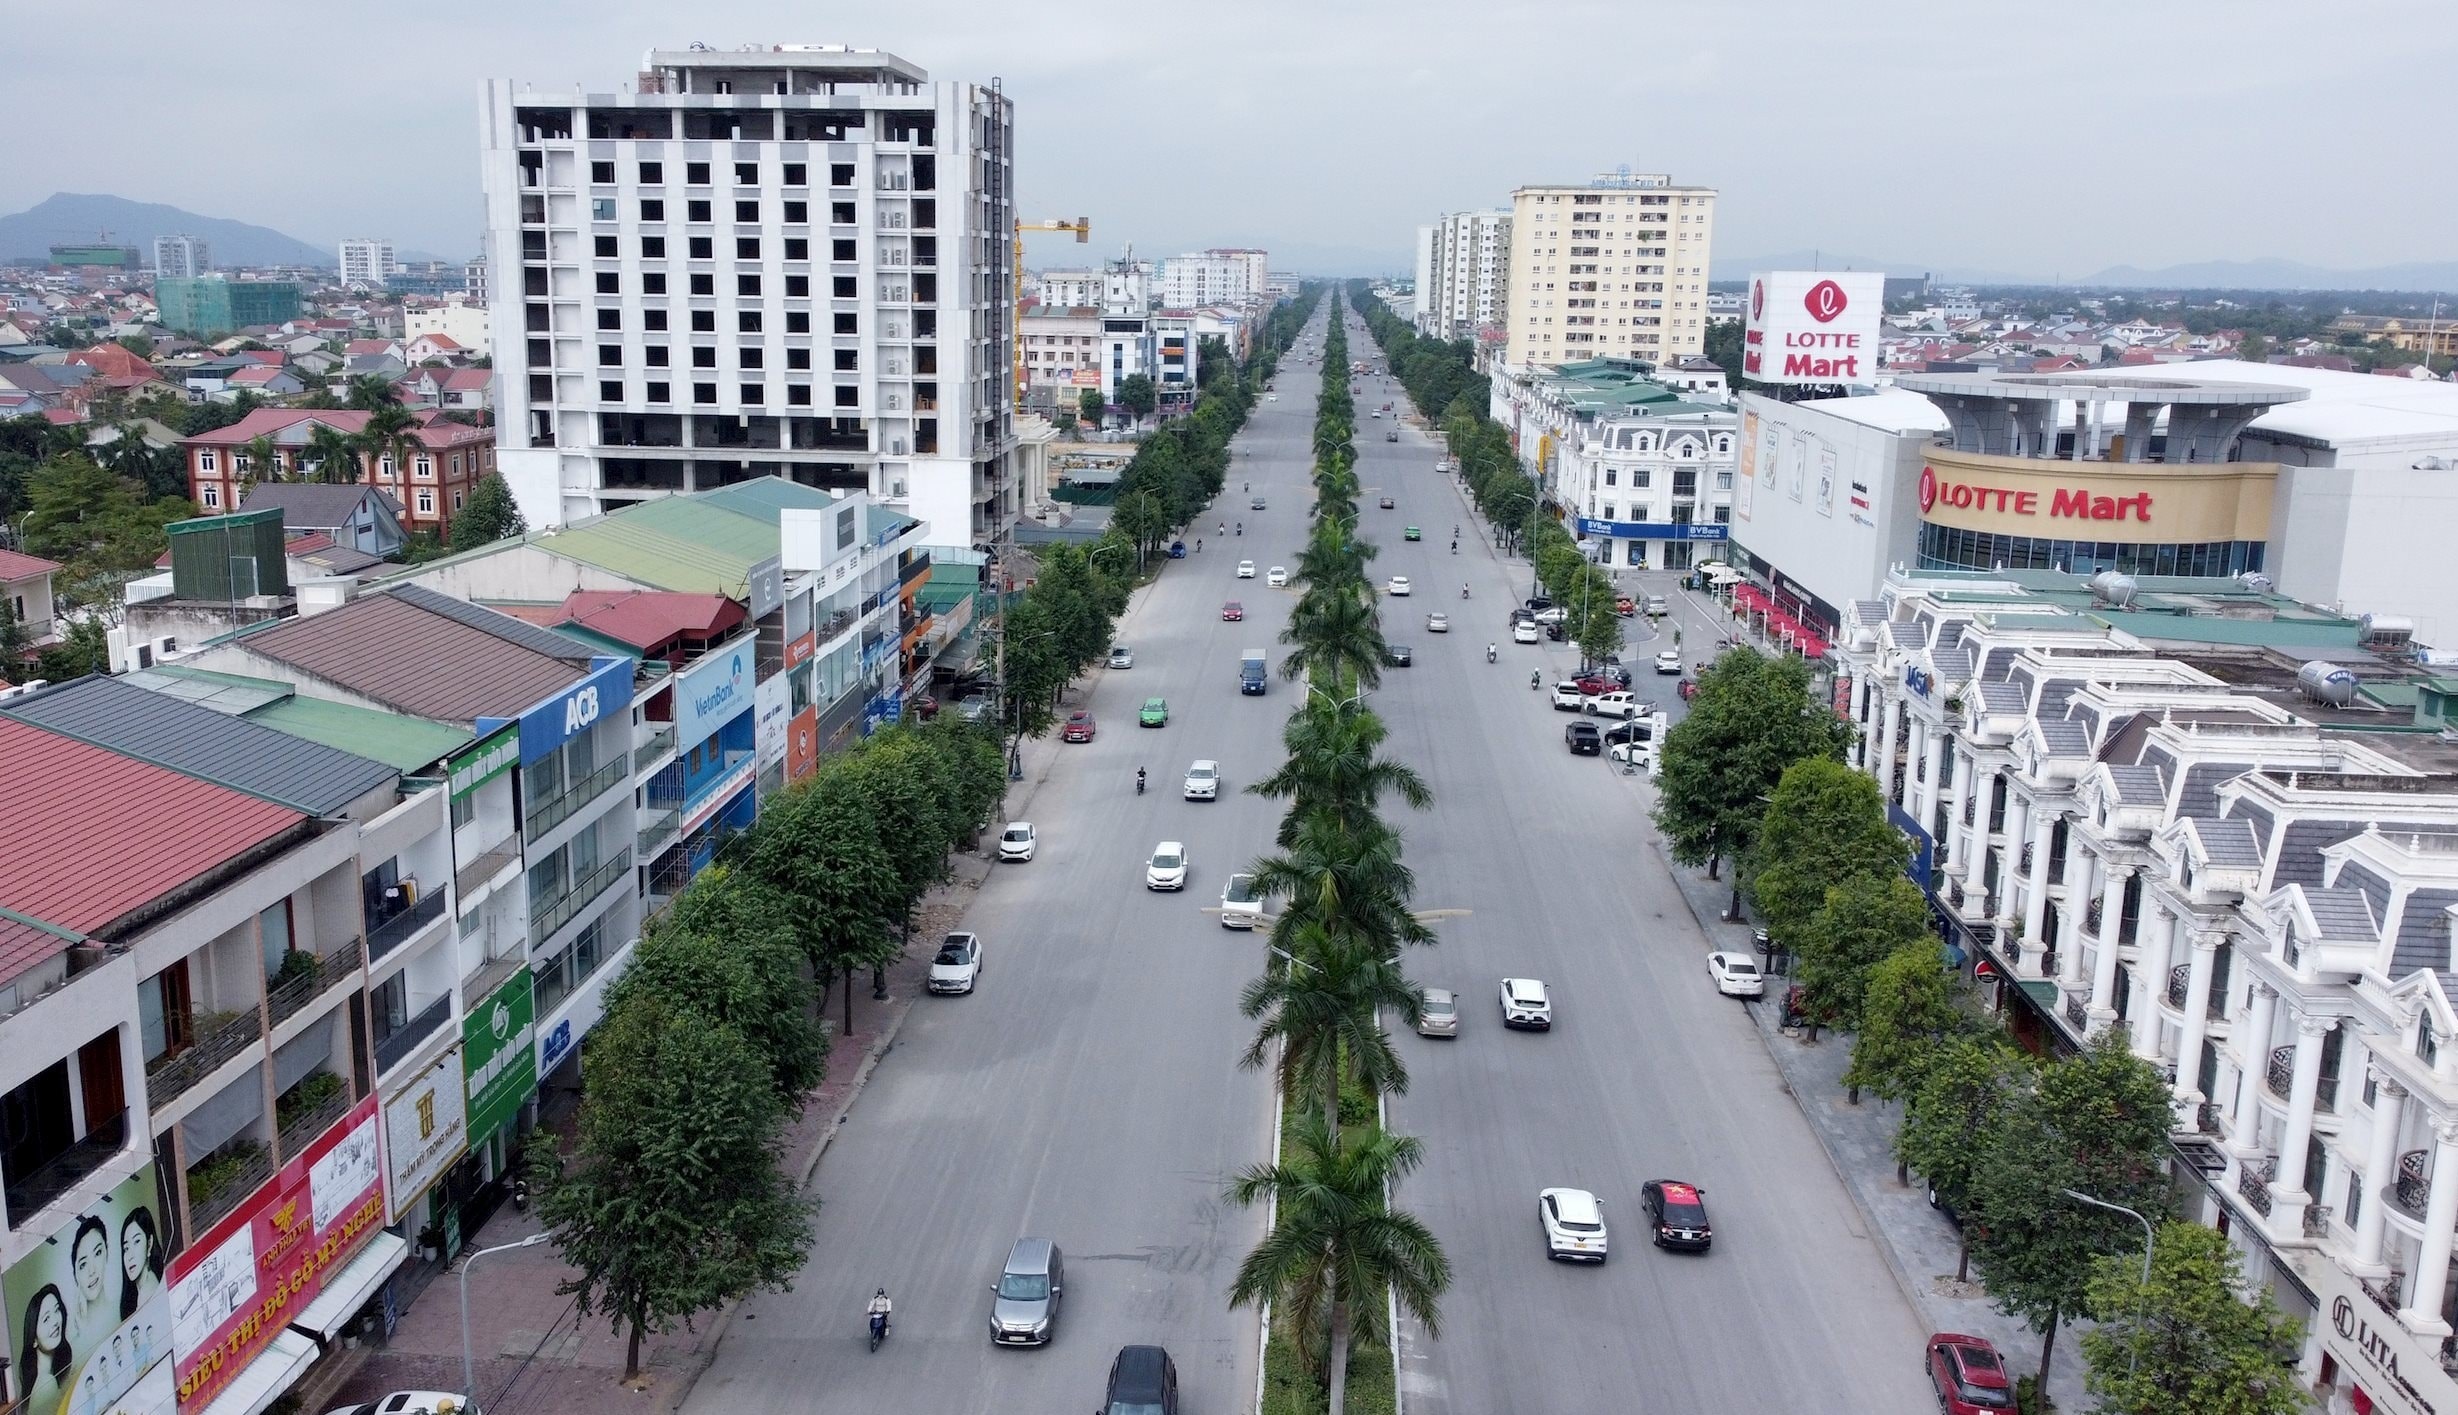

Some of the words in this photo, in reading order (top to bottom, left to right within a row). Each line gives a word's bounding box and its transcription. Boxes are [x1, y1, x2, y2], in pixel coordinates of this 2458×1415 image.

[1785, 332, 1860, 348] LOTTE
[1784, 353, 1858, 377] Mart
[1940, 482, 2038, 515] LOTTE
[2050, 487, 2153, 522] Mart
[1690, 526, 1720, 535] BVBank
[565, 686, 599, 735] ACB
[695, 679, 734, 719] VietinBank
[541, 1019, 571, 1071] ACB
[227, 1314, 262, 1356] THỊ
[262, 1274, 289, 1323] ĐỒ
[291, 1248, 314, 1294] GỖ
[315, 1228, 340, 1271] MỸ
[2358, 1319, 2399, 1381] LITA
